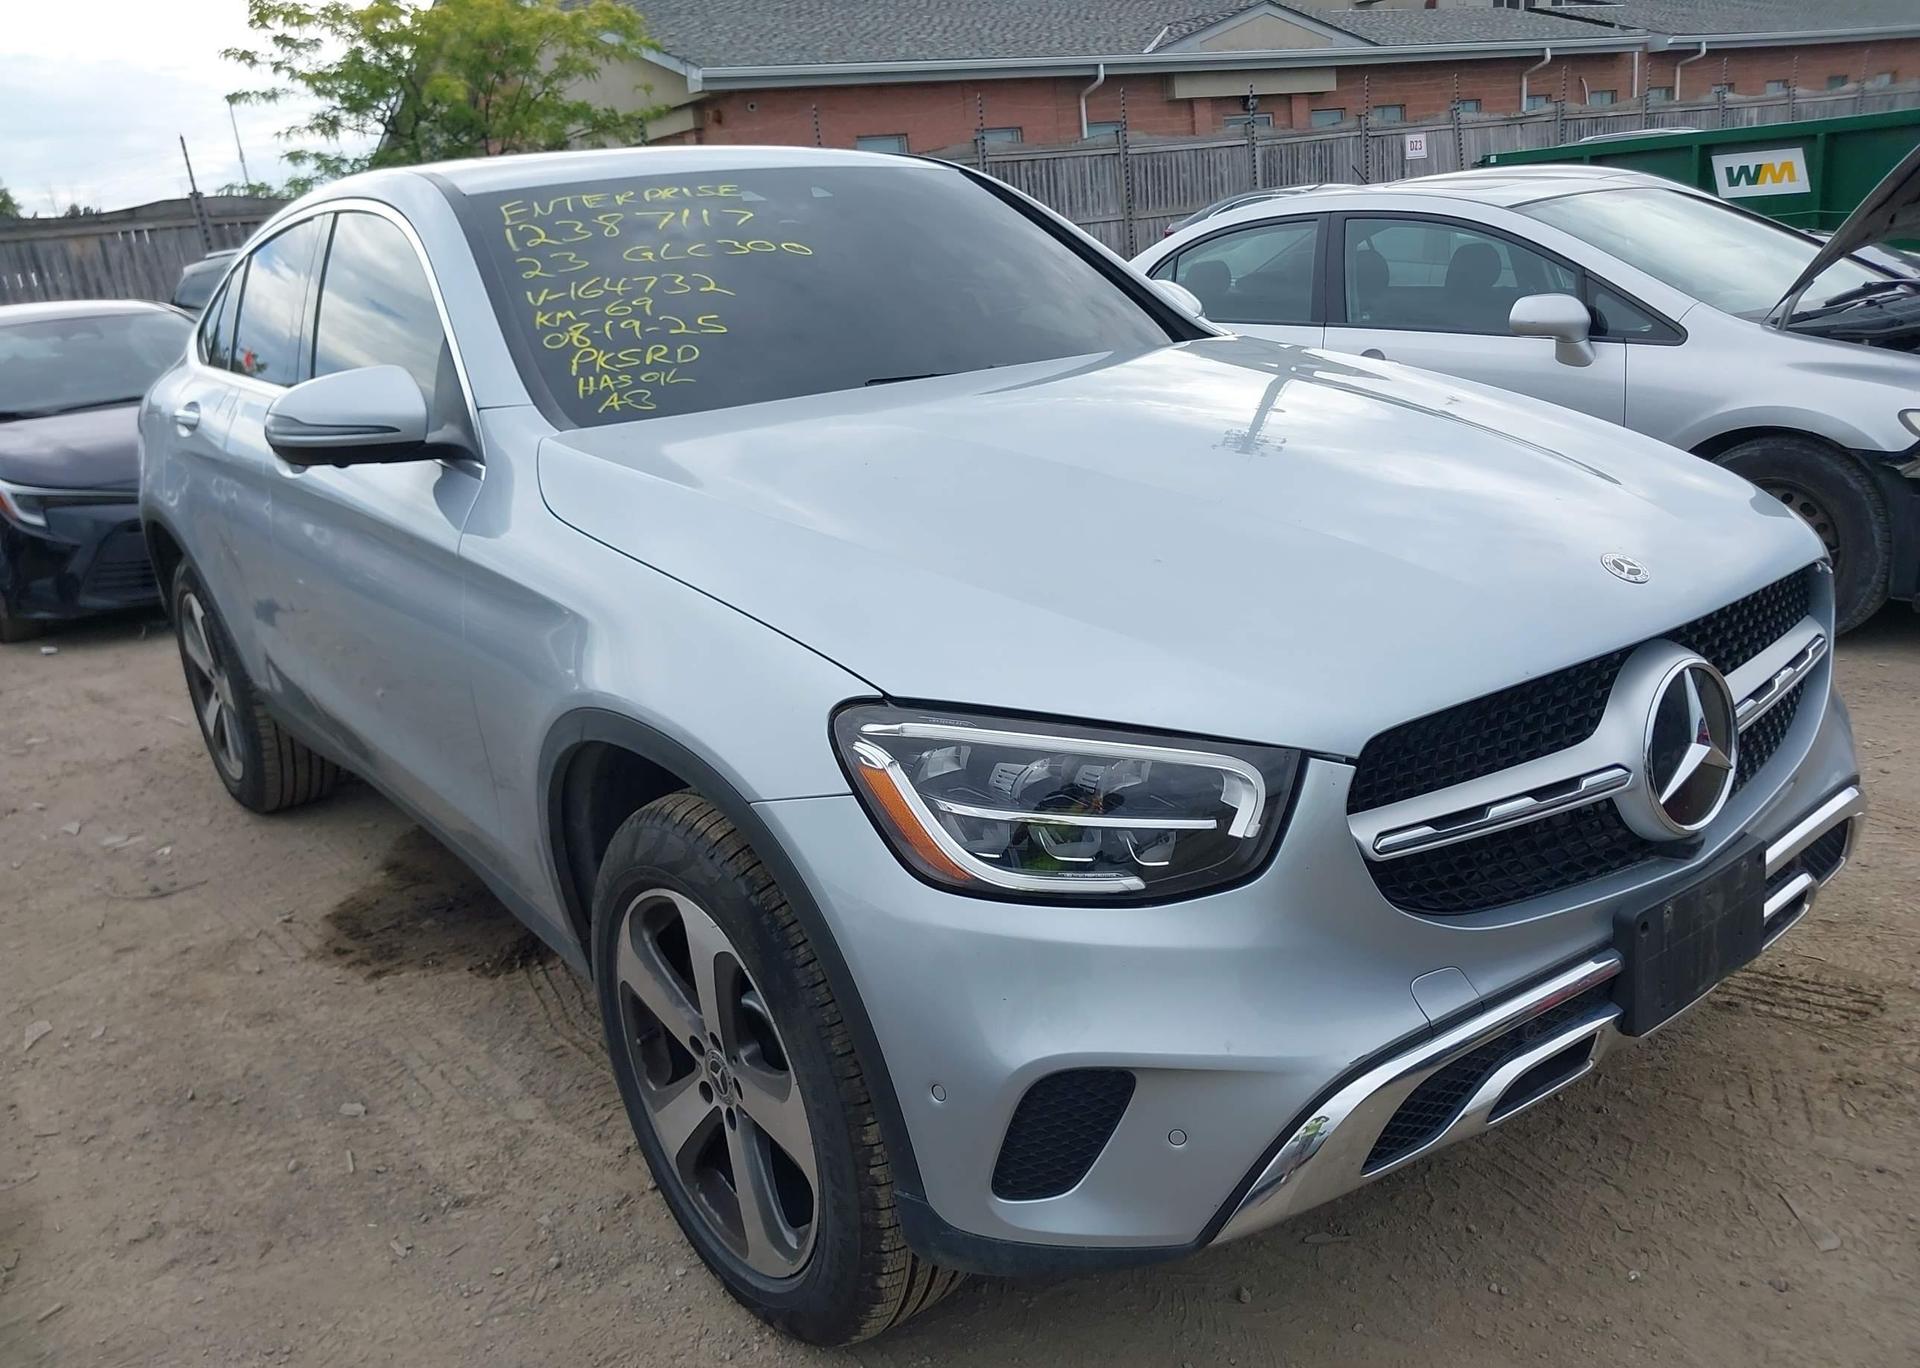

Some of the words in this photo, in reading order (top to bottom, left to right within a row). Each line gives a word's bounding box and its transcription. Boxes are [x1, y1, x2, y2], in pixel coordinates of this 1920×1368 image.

[1725, 161, 1796, 187] WM
[501, 184, 738, 226] ENTERPRISE
[515, 252, 590, 278] 23
[622, 240, 812, 262] GLC300
[543, 315, 728, 348] 08-19-25
[578, 374, 633, 399] HAS
